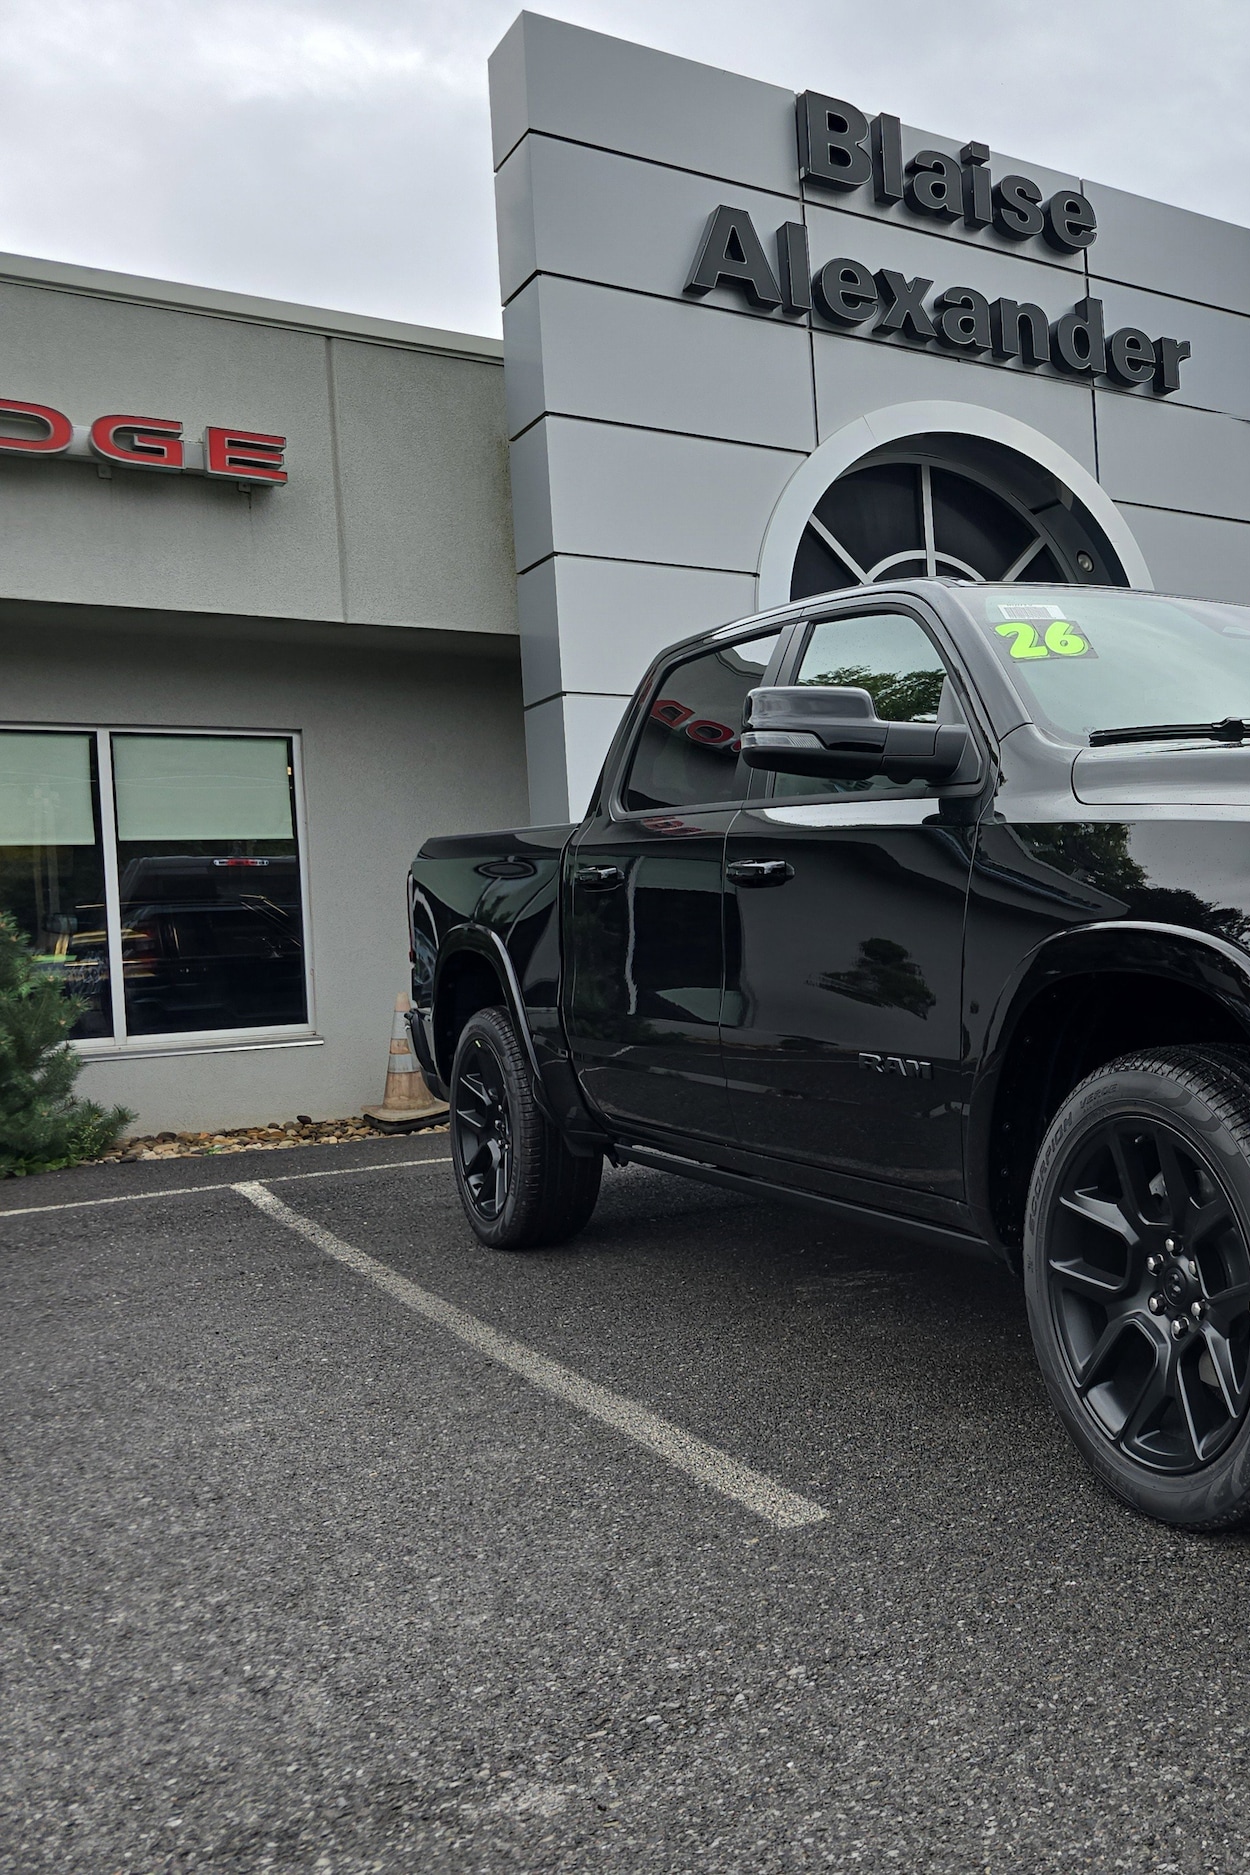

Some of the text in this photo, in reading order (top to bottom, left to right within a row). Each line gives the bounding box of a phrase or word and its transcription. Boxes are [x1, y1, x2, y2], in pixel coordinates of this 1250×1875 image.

[798, 90, 1097, 254] Blaise
[683, 205, 1191, 395] Alexander
[995, 621, 1089, 659] 26
[859, 1052, 933, 1080] RAM
